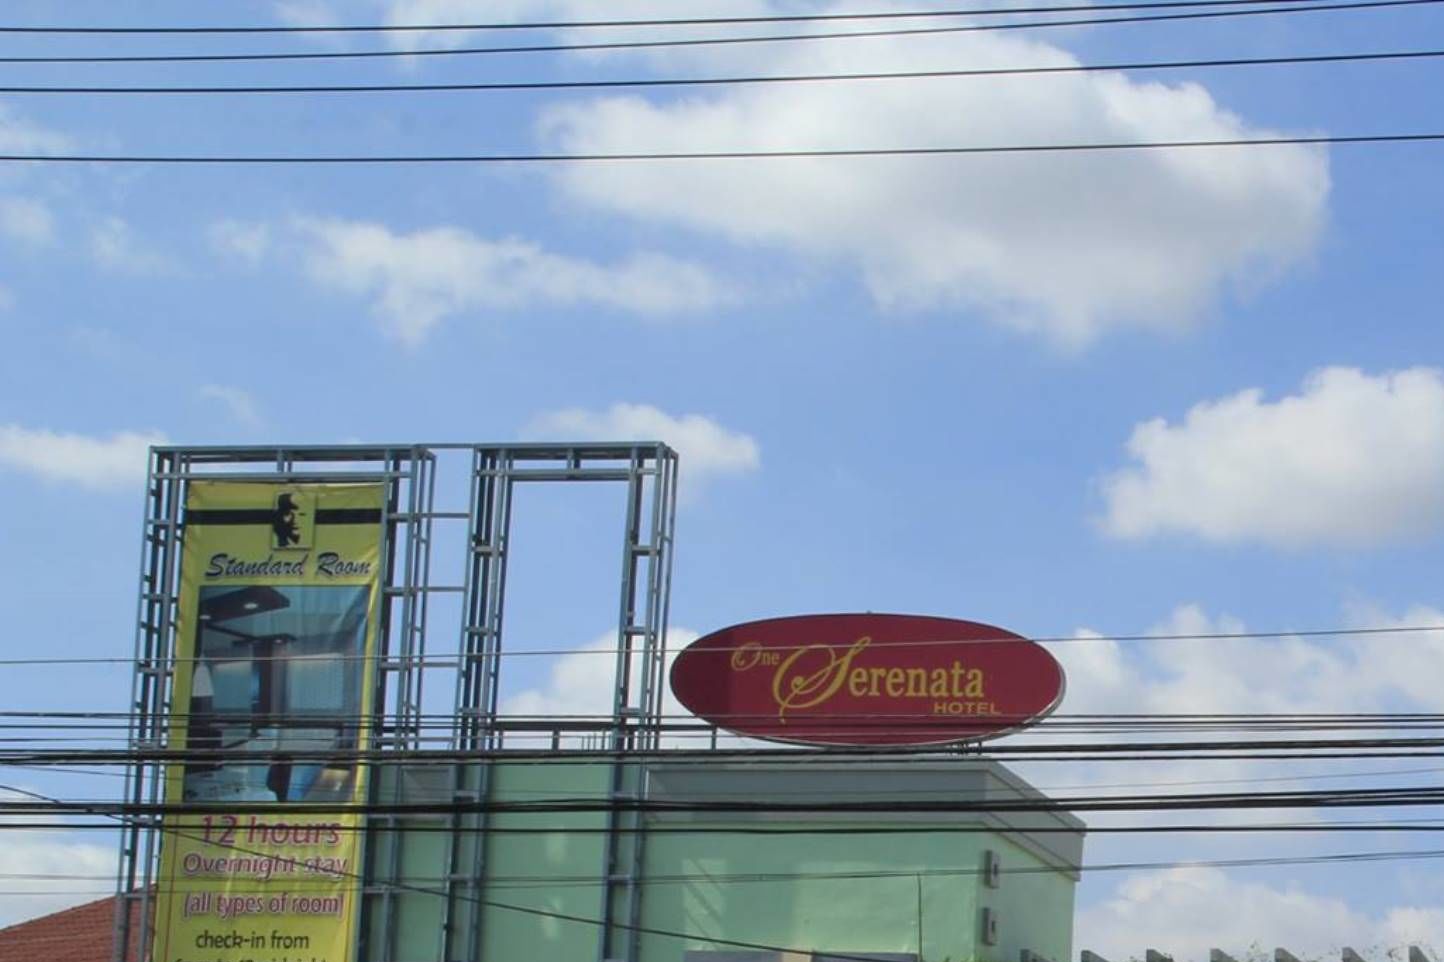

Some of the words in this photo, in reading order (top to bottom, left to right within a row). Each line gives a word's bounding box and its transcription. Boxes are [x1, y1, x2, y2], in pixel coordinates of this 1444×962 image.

[205, 552, 309, 577] Standard
[315, 552, 373, 579] Room
[730, 642, 780, 671] One
[771, 636, 985, 724] Serenata
[934, 701, 1002, 715] HOTEL
[201, 815, 239, 846] 12
[246, 815, 342, 846] hours
[183, 853, 296, 881] Overnight
[304, 856, 349, 882] stay
[216, 893, 265, 920] types
[268, 892, 289, 913] of
[291, 893, 345, 920] room)
[195, 929, 266, 949] check-in
[271, 931, 310, 949] from
